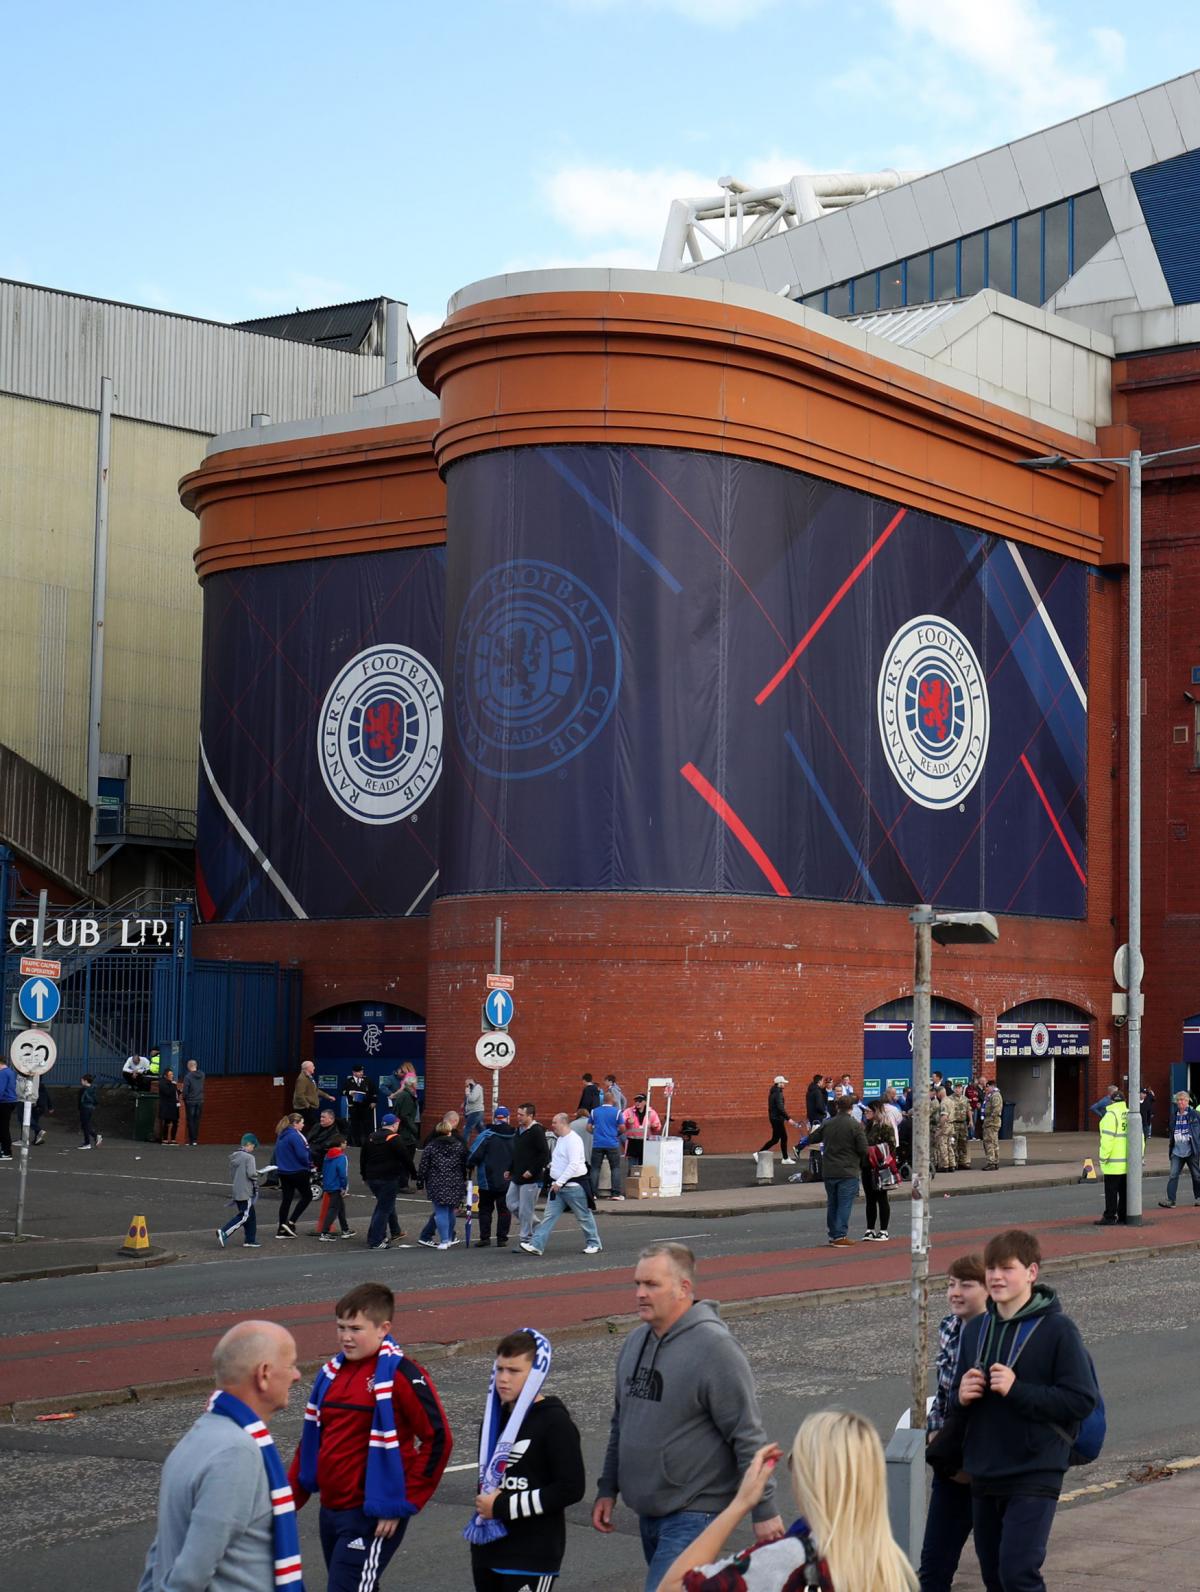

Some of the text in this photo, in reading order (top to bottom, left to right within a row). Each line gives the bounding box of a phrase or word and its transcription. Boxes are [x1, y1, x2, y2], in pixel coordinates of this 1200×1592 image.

[488, 568, 608, 649] FOOTBALL
[362, 656, 440, 718] FOOTBALL
[917, 628, 981, 701] FOOTBALL
[495, 725, 544, 743] READY
[549, 685, 609, 756] CLUB
[885, 655, 916, 782] RANGERS
[325, 692, 360, 804] RANGERS
[404, 744, 439, 801] CLUB
[920, 756, 951, 775] READY
[953, 735, 981, 789] CLUB
[365, 777, 400, 792] READY
[9, 918, 100, 947] CLUB
[483, 1042, 509, 1057] 20
